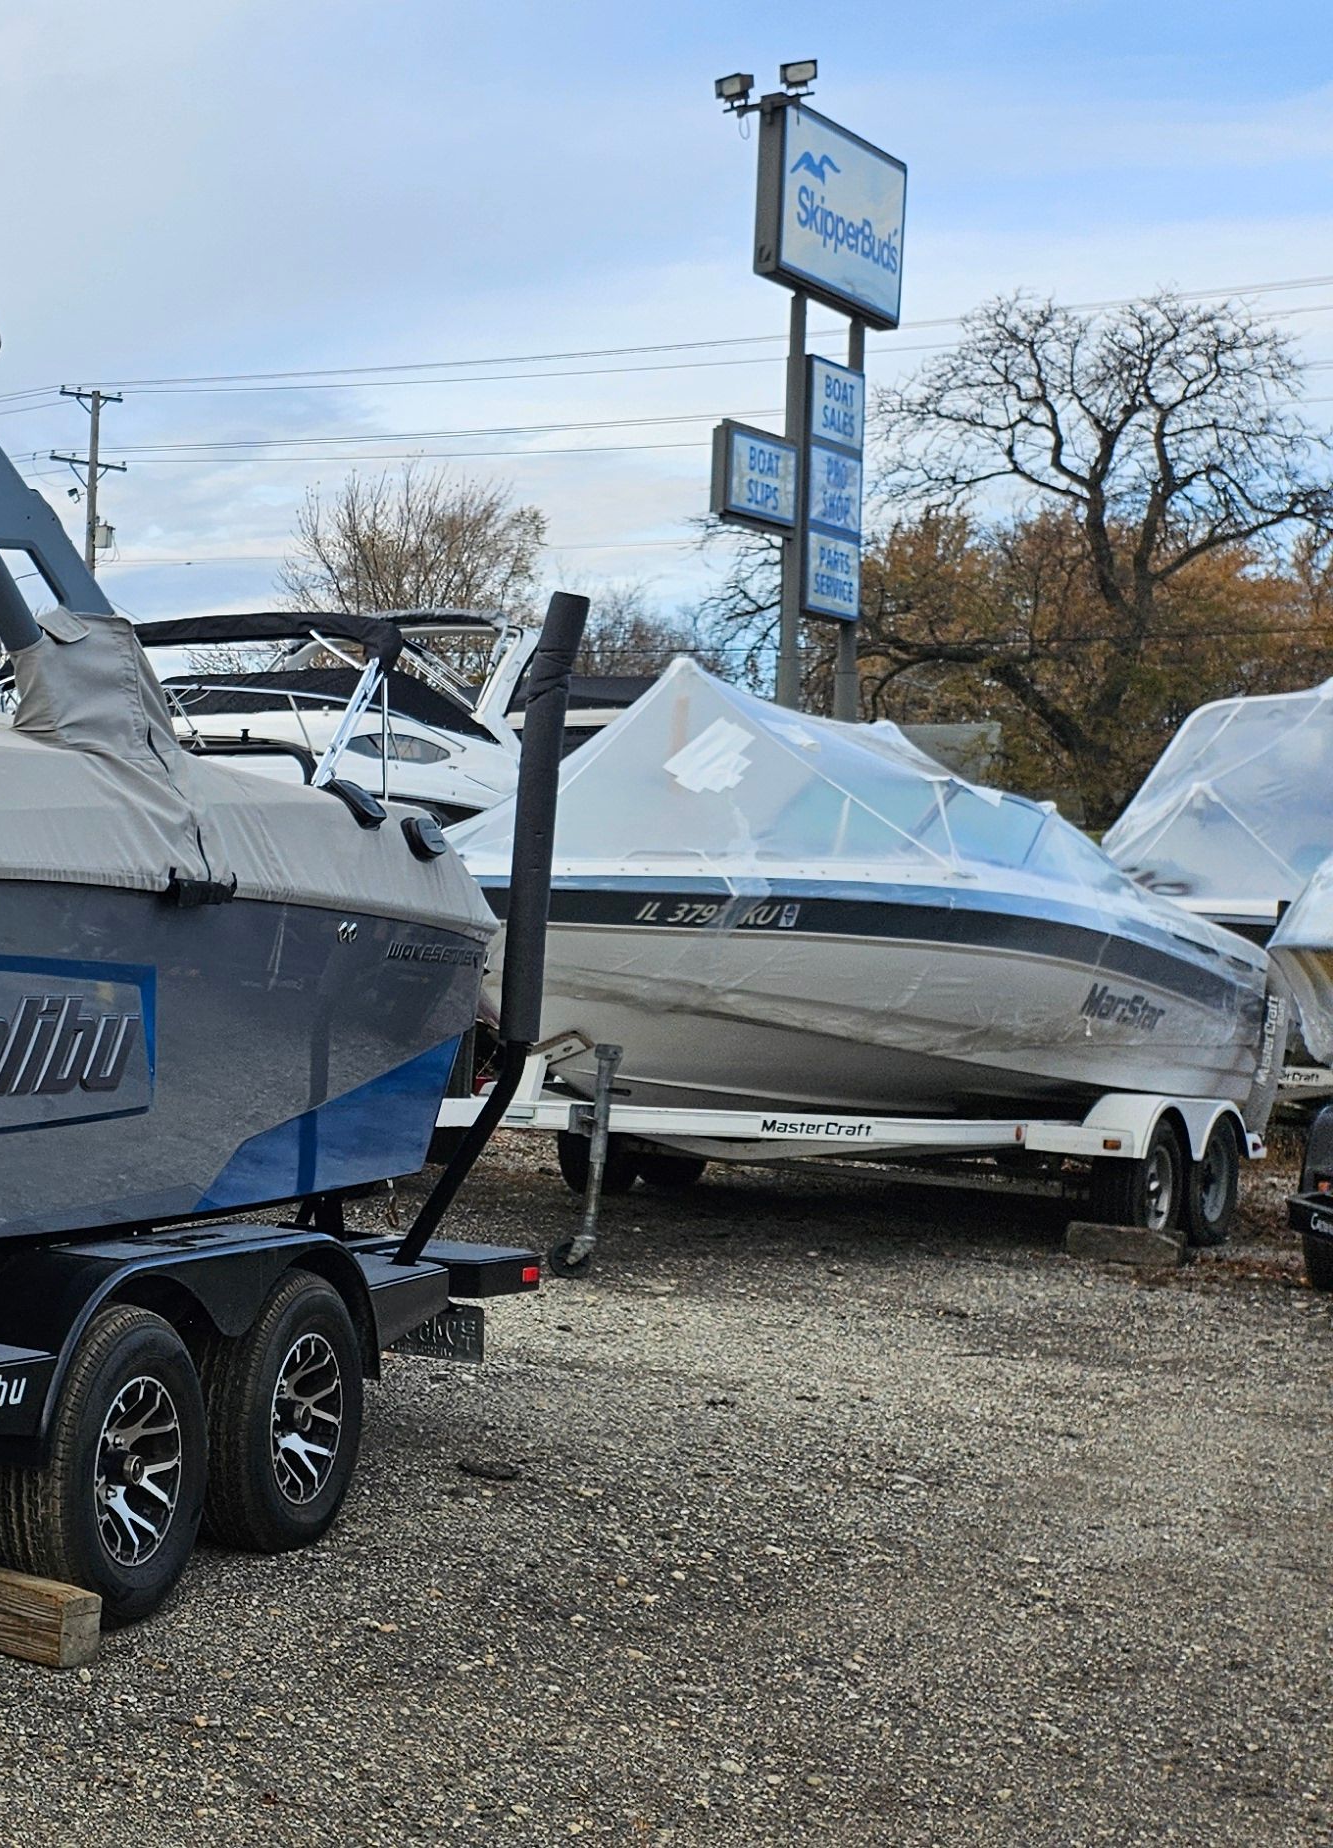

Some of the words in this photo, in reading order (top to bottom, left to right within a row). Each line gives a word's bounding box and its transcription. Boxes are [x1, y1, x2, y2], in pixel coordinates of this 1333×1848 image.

[824, 374, 855, 409] BOAT
[821, 404, 855, 438] SALES
[748, 446, 781, 479] BOAT
[747, 478, 779, 511] SLIPS
[821, 490, 851, 523] SHOP
[819, 546, 851, 575] PARTS
[813, 572, 854, 604] SERVICE
[635, 901, 662, 921] IL
[739, 904, 781, 926] KU
[761, 1119, 873, 1137] MasterCraft
